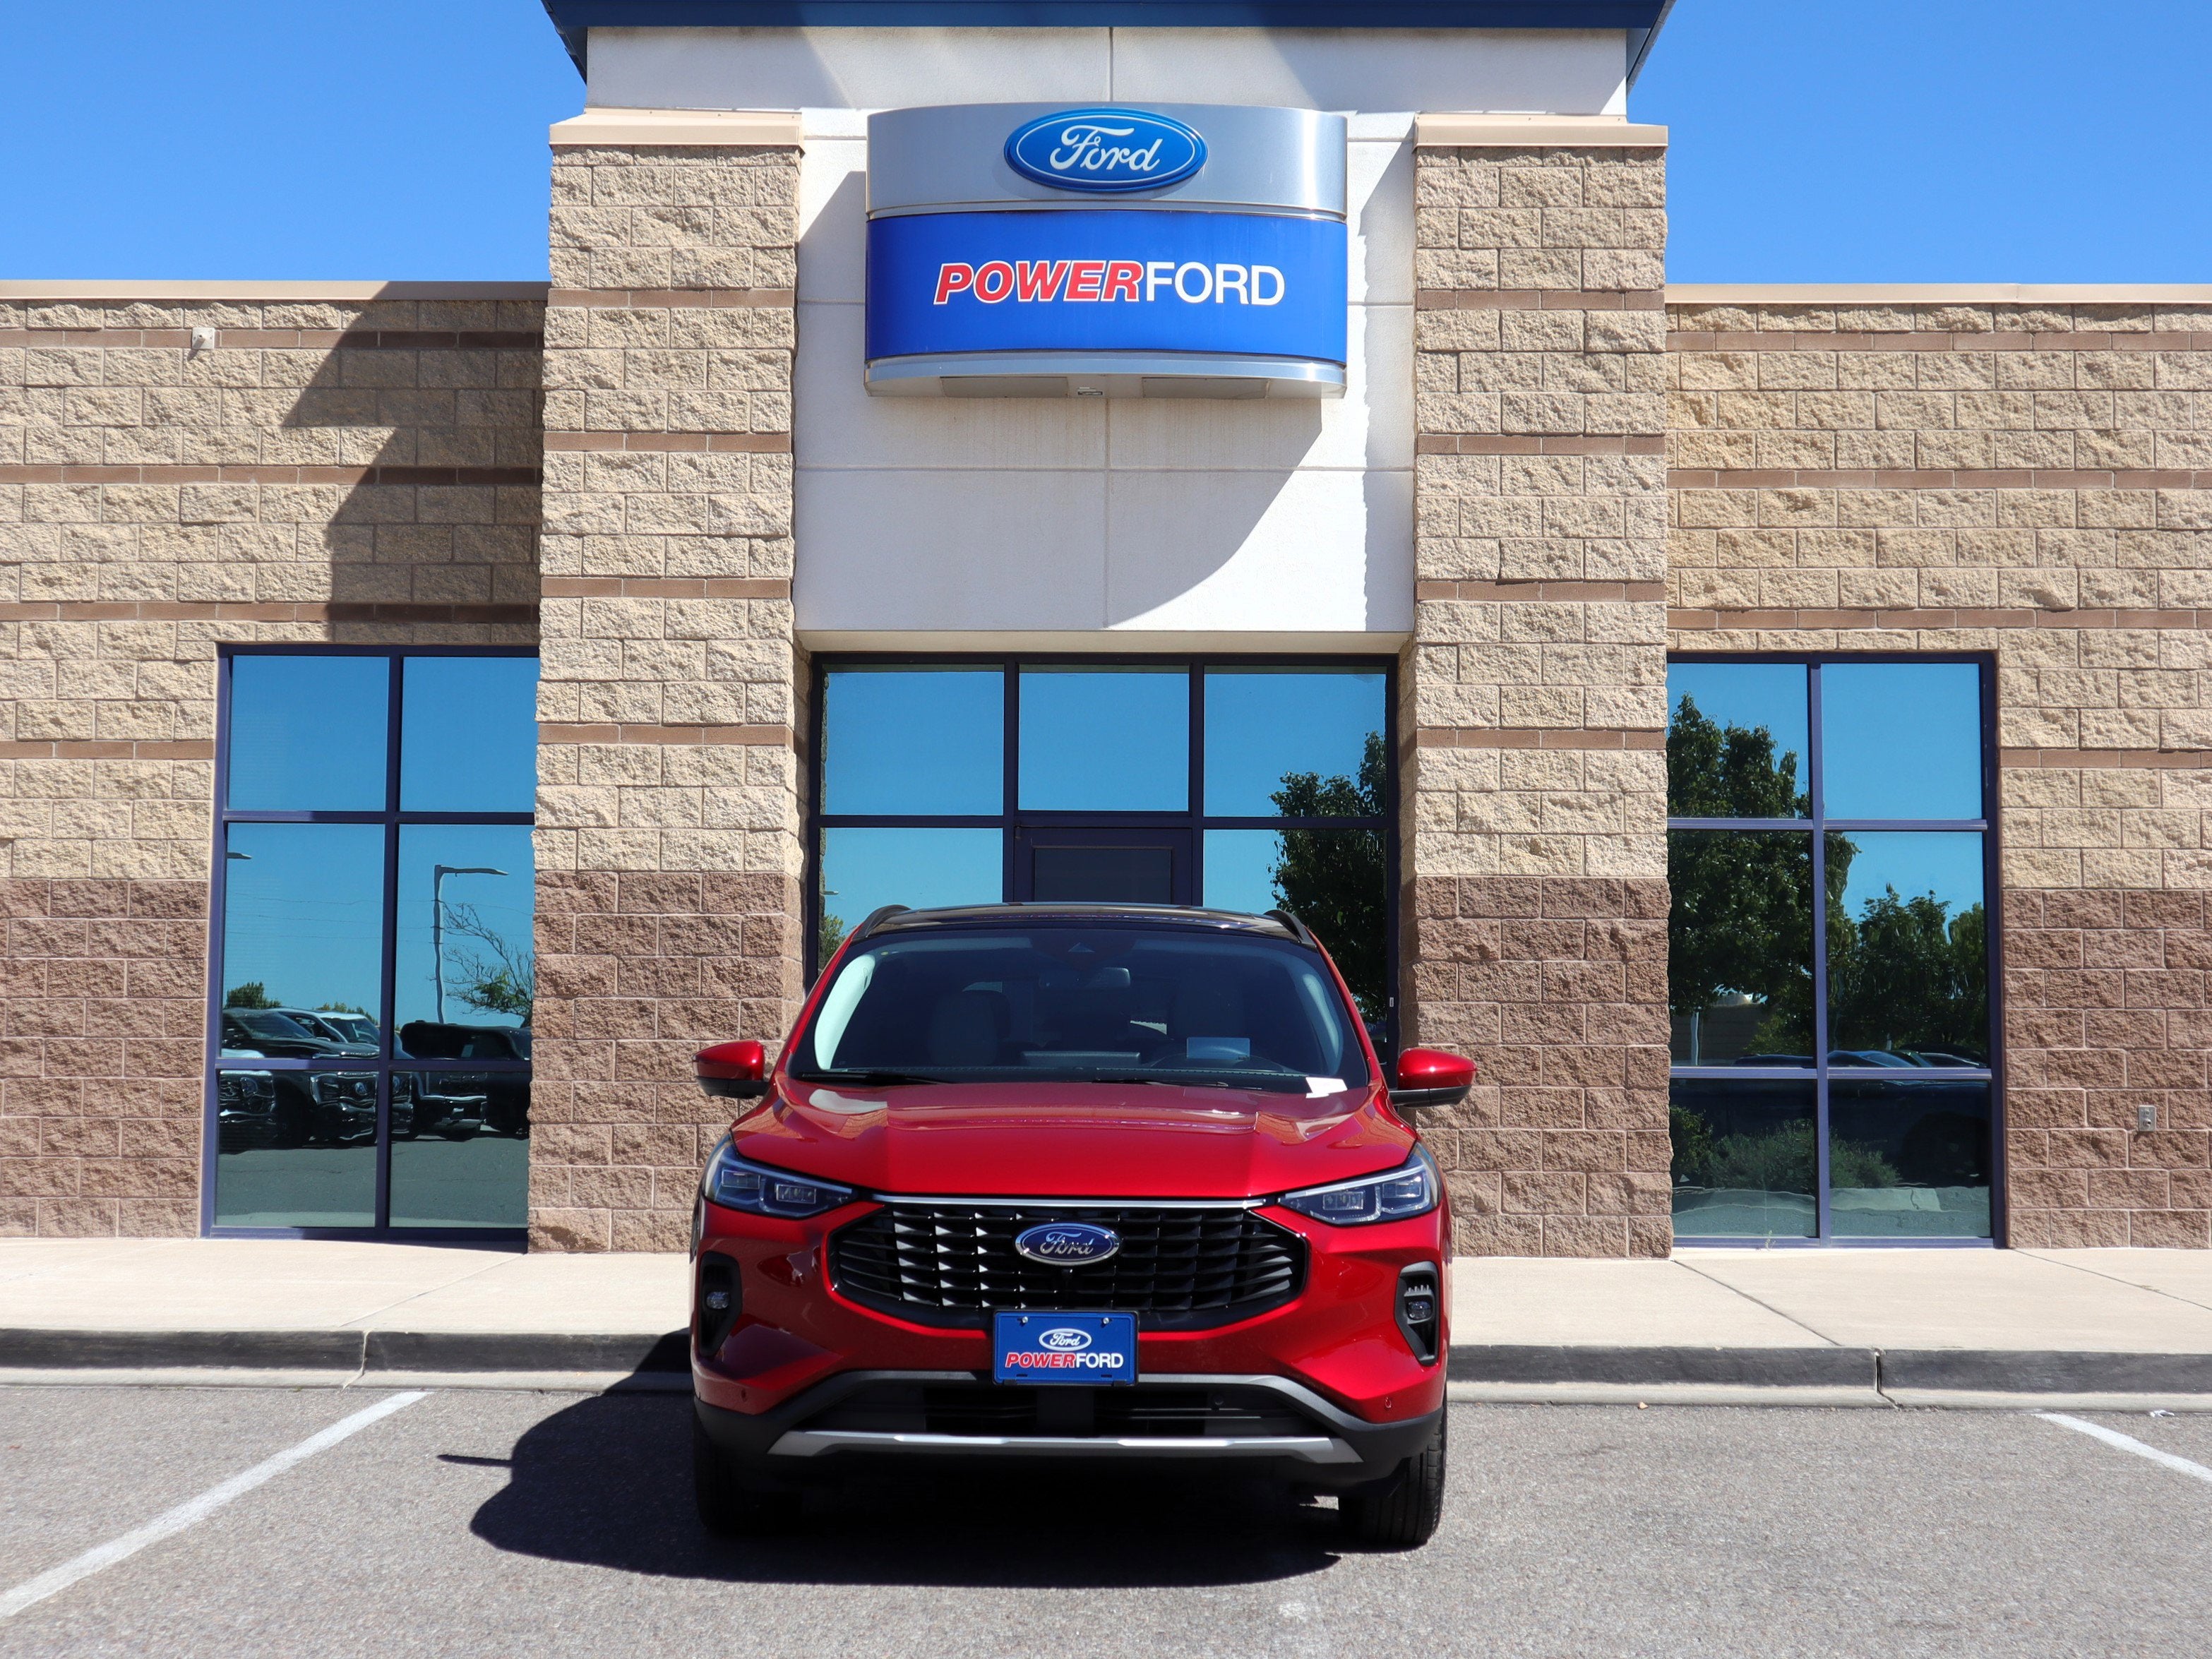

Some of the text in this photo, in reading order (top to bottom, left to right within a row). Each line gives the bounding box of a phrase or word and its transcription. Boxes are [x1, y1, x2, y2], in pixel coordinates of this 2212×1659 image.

[1049, 125, 1162, 171] Ford
[1040, 1231, 1094, 1254] Ford
[1049, 1333, 1080, 1347] Ford
